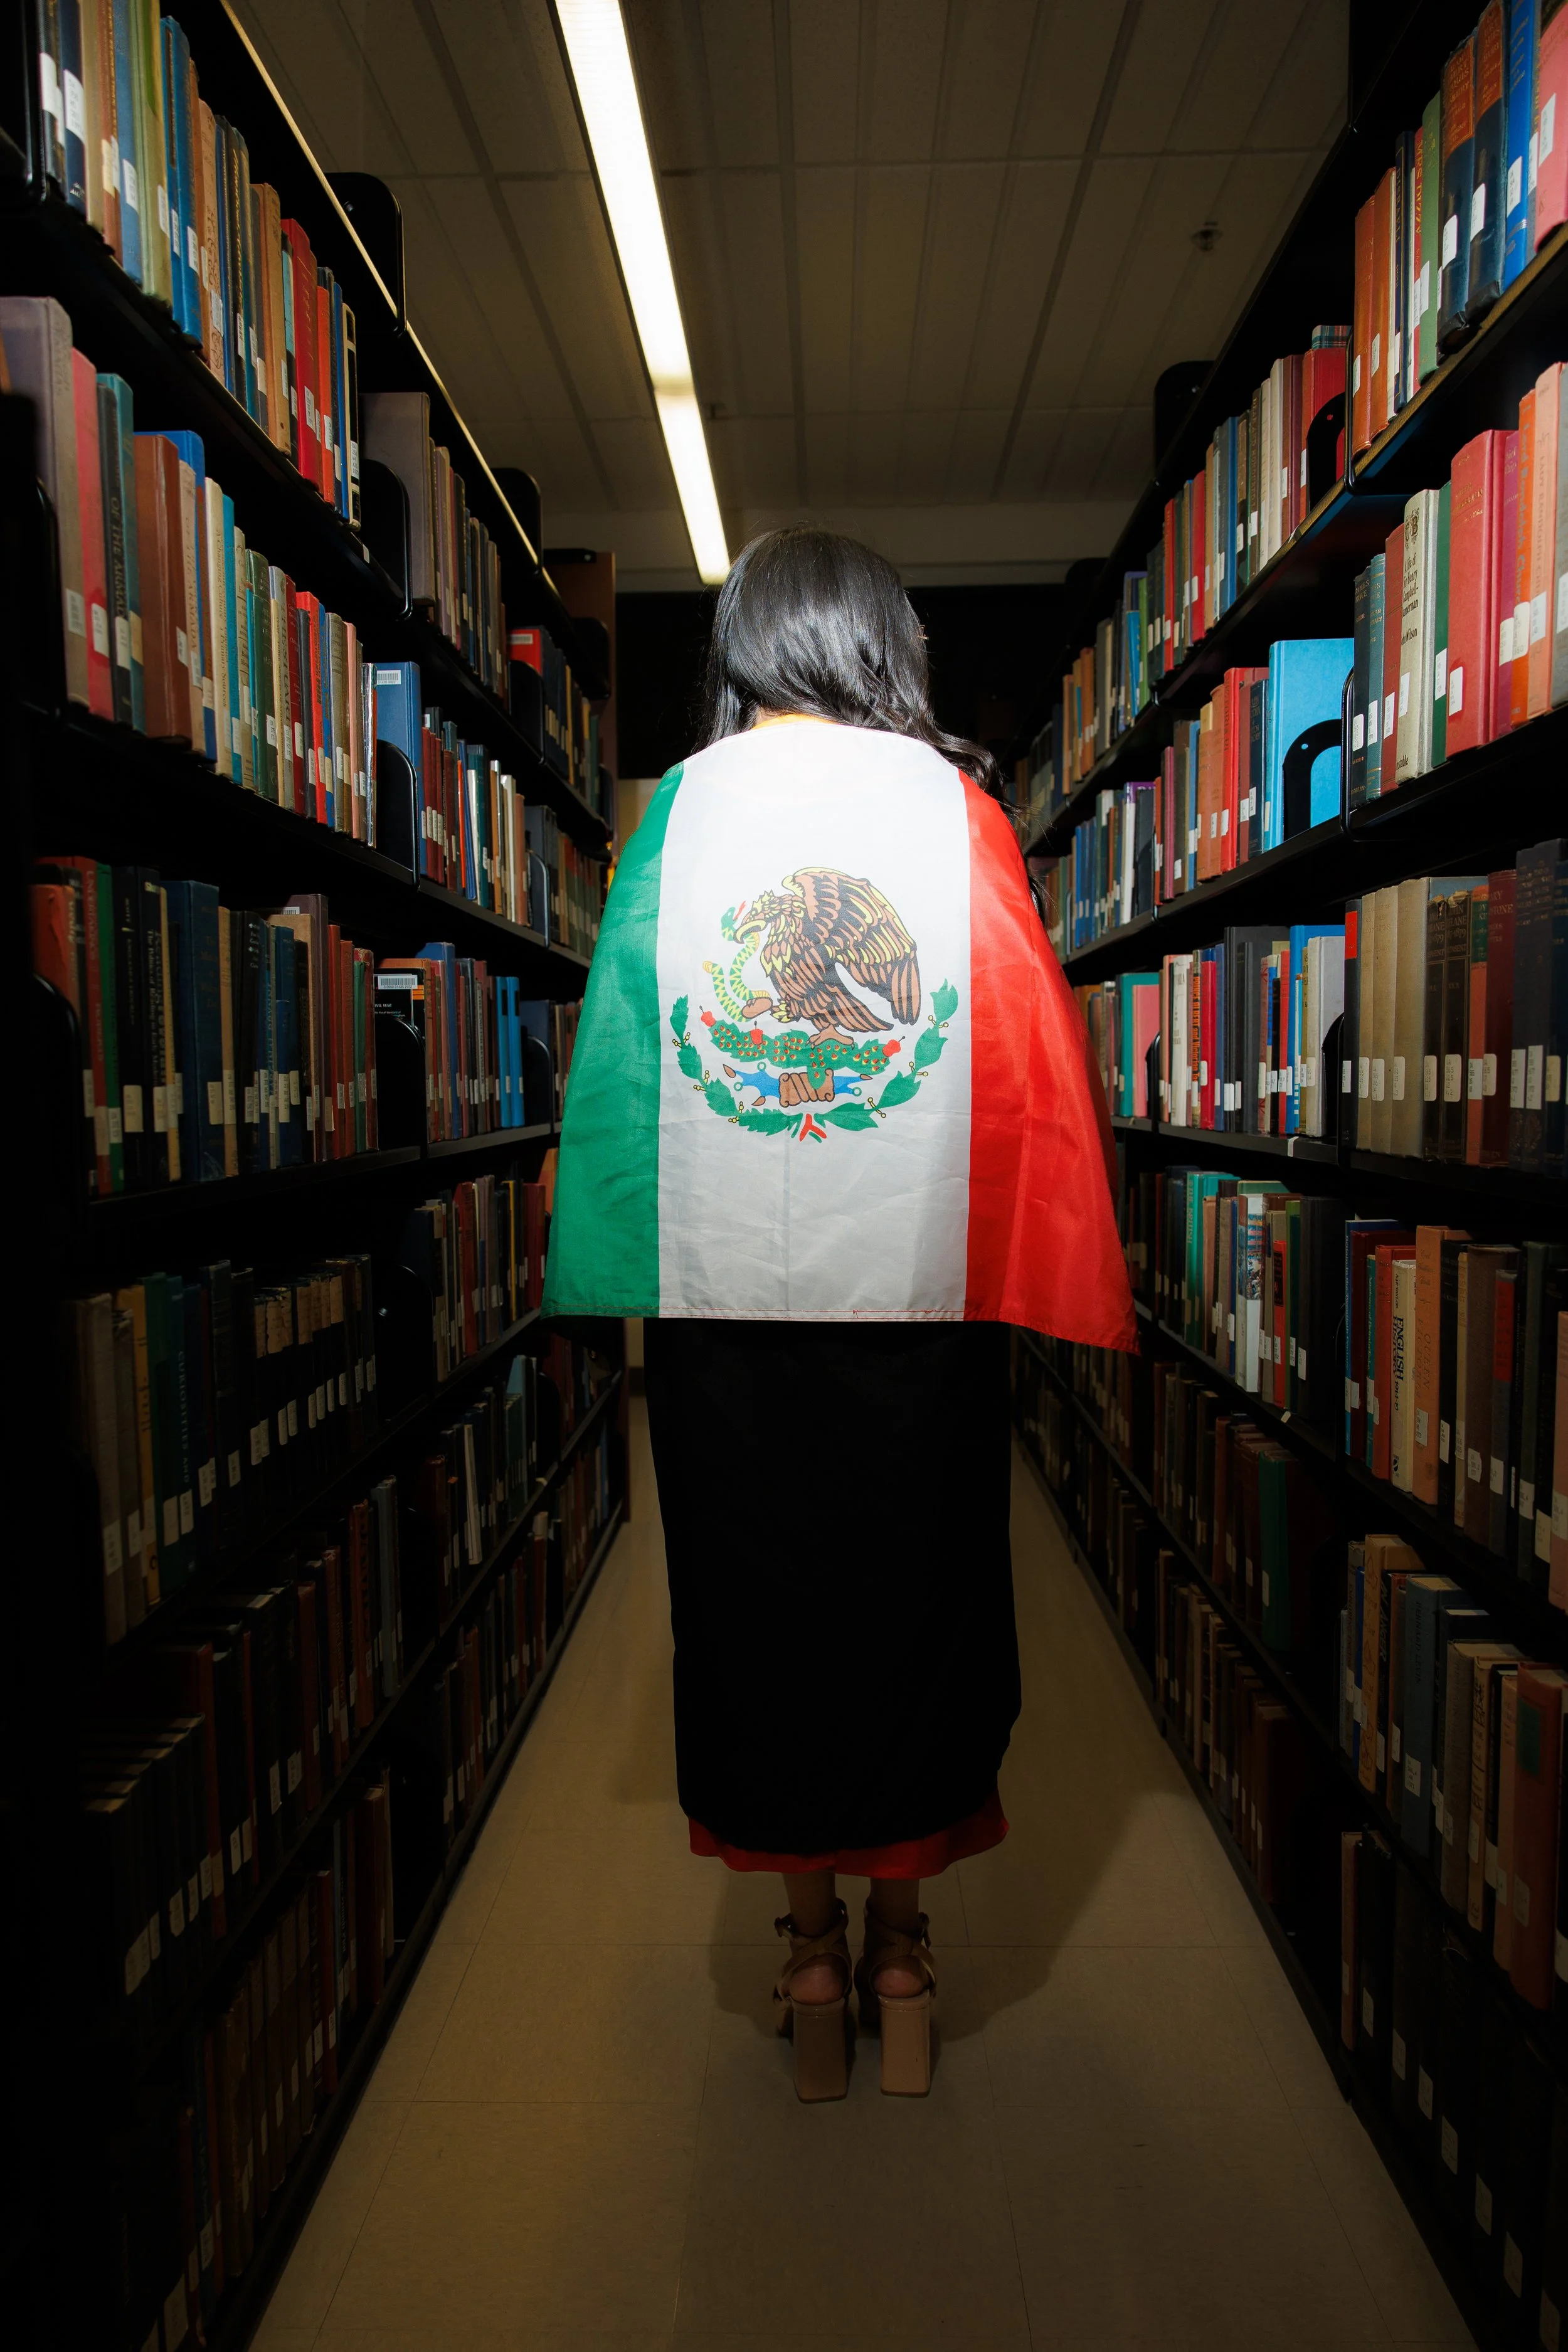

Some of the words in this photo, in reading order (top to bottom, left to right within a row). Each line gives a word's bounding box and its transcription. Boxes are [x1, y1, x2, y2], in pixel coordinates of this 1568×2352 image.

[1416, 139, 1424, 181] MRS
[1407, 569, 1417, 586] Henry
[1406, 627, 1417, 644] Wilson
[1396, 1316, 1404, 1381] ENGLISH
[1423, 1333, 1431, 1390] QUEEN
[1380, 1607, 1389, 1662] ANGER
